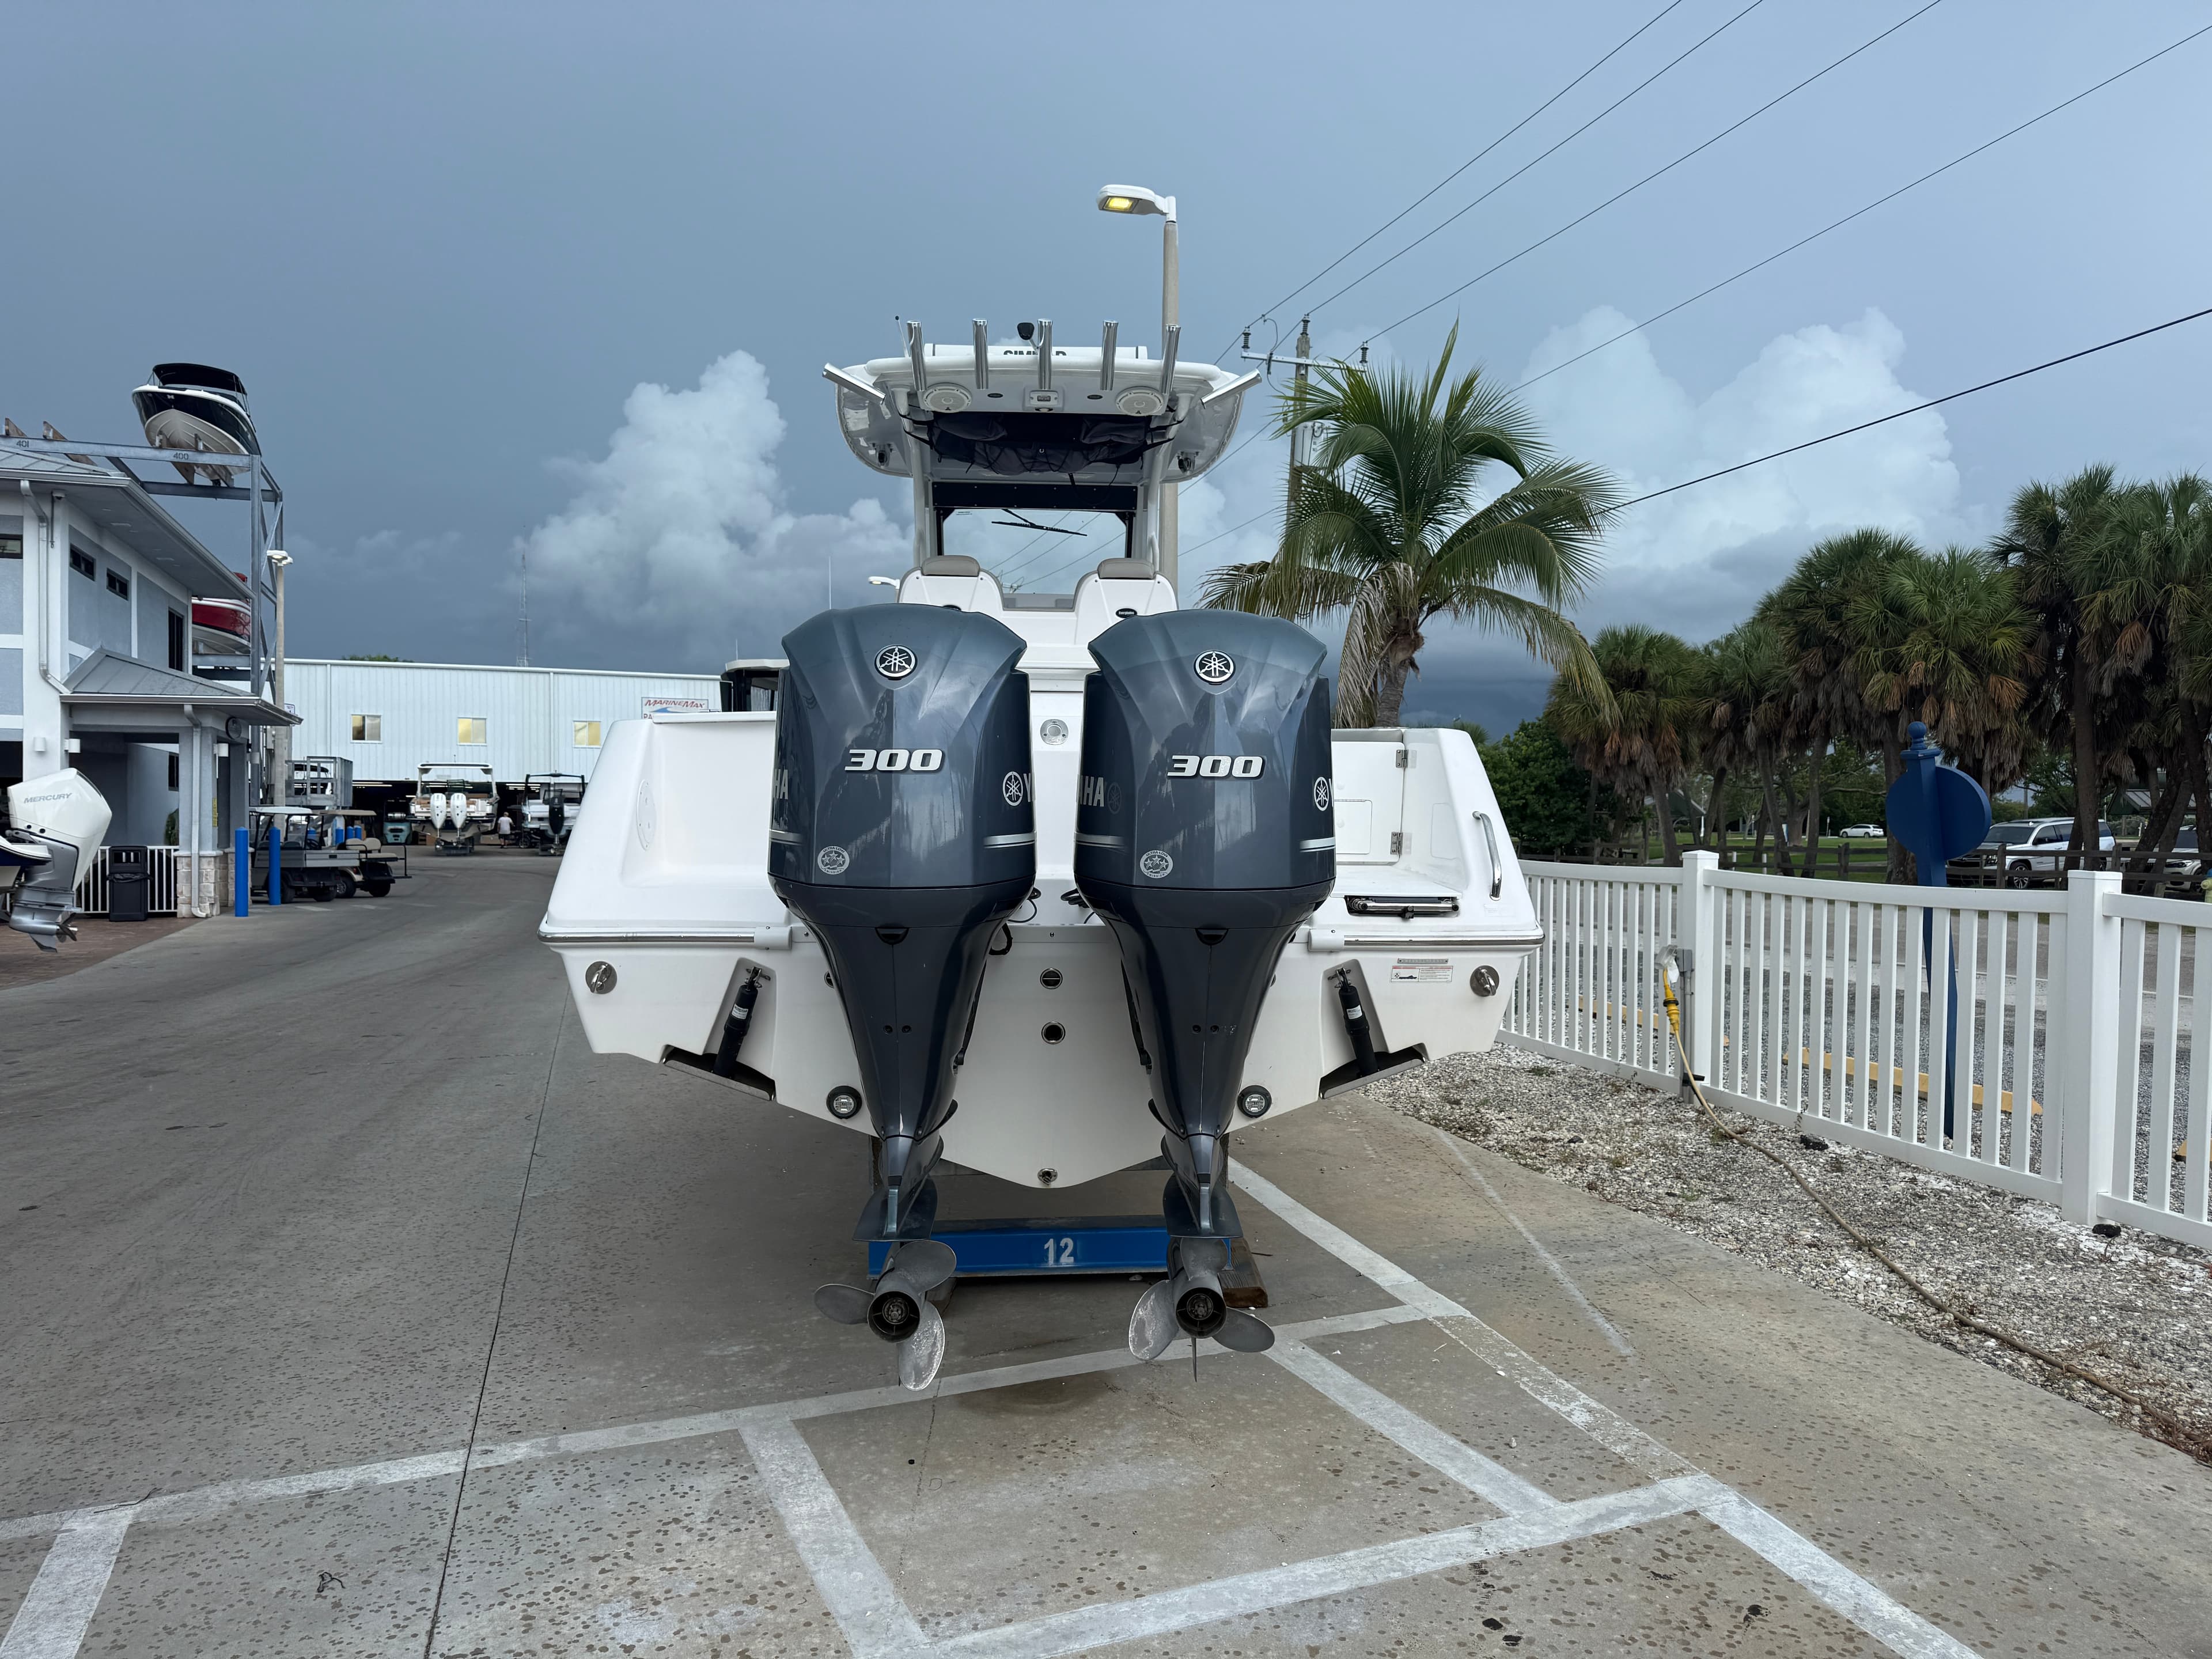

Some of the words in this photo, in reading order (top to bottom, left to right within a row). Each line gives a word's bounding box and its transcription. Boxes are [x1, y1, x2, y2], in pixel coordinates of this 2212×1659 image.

[173, 452, 189, 460] 400
[844, 749, 943, 771] 300
[1167, 755, 1263, 778] 300
[24, 793, 73, 804] MERCURY
[1044, 1237, 1074, 1264] 12
